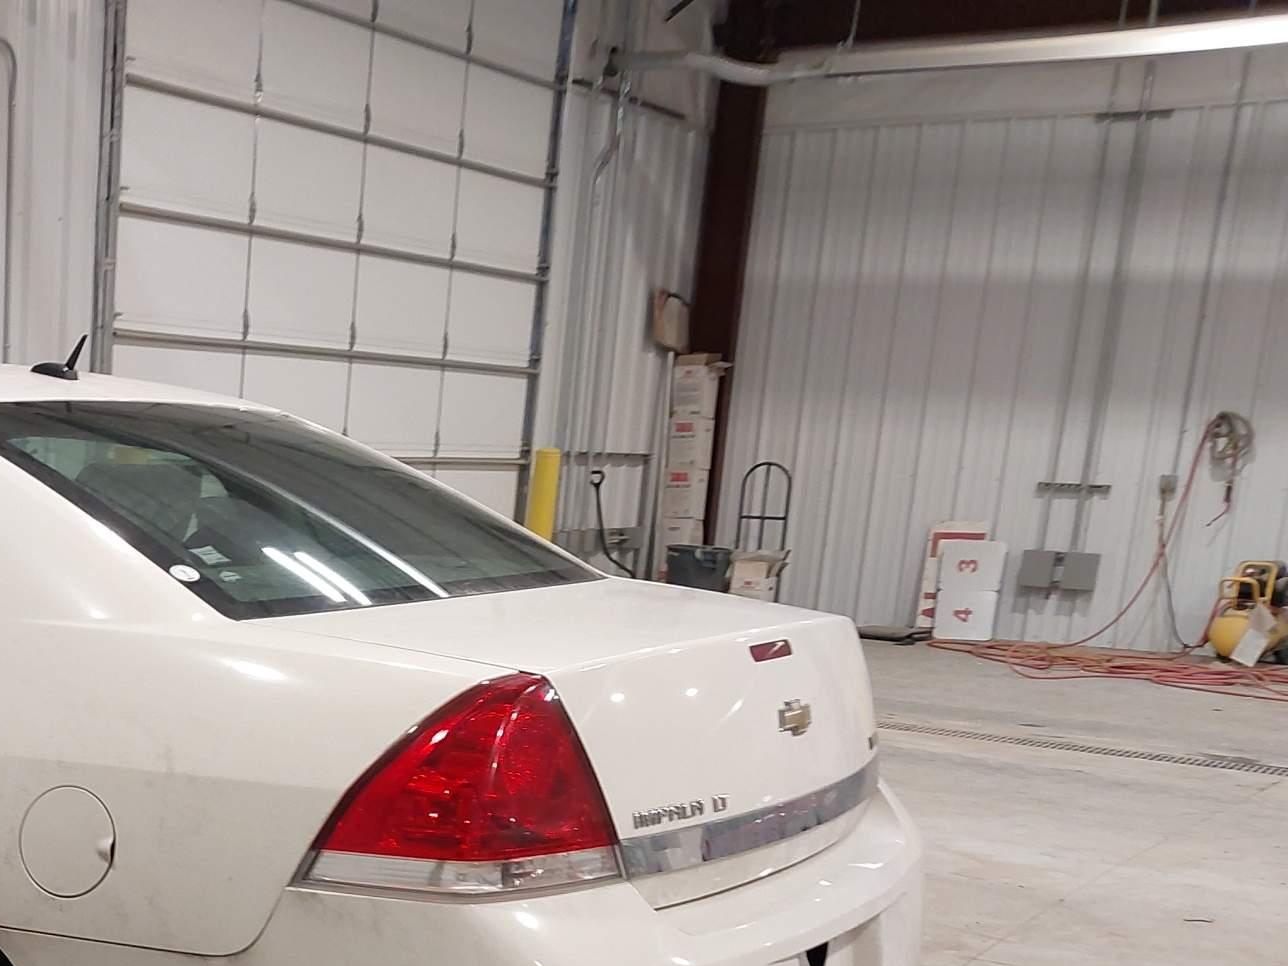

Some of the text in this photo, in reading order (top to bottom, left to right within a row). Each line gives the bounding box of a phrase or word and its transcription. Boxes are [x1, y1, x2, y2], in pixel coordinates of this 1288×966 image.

[957, 559, 979, 573] 3
[952, 608, 974, 623] 4
[632, 793, 731, 829] IMPALA LT
